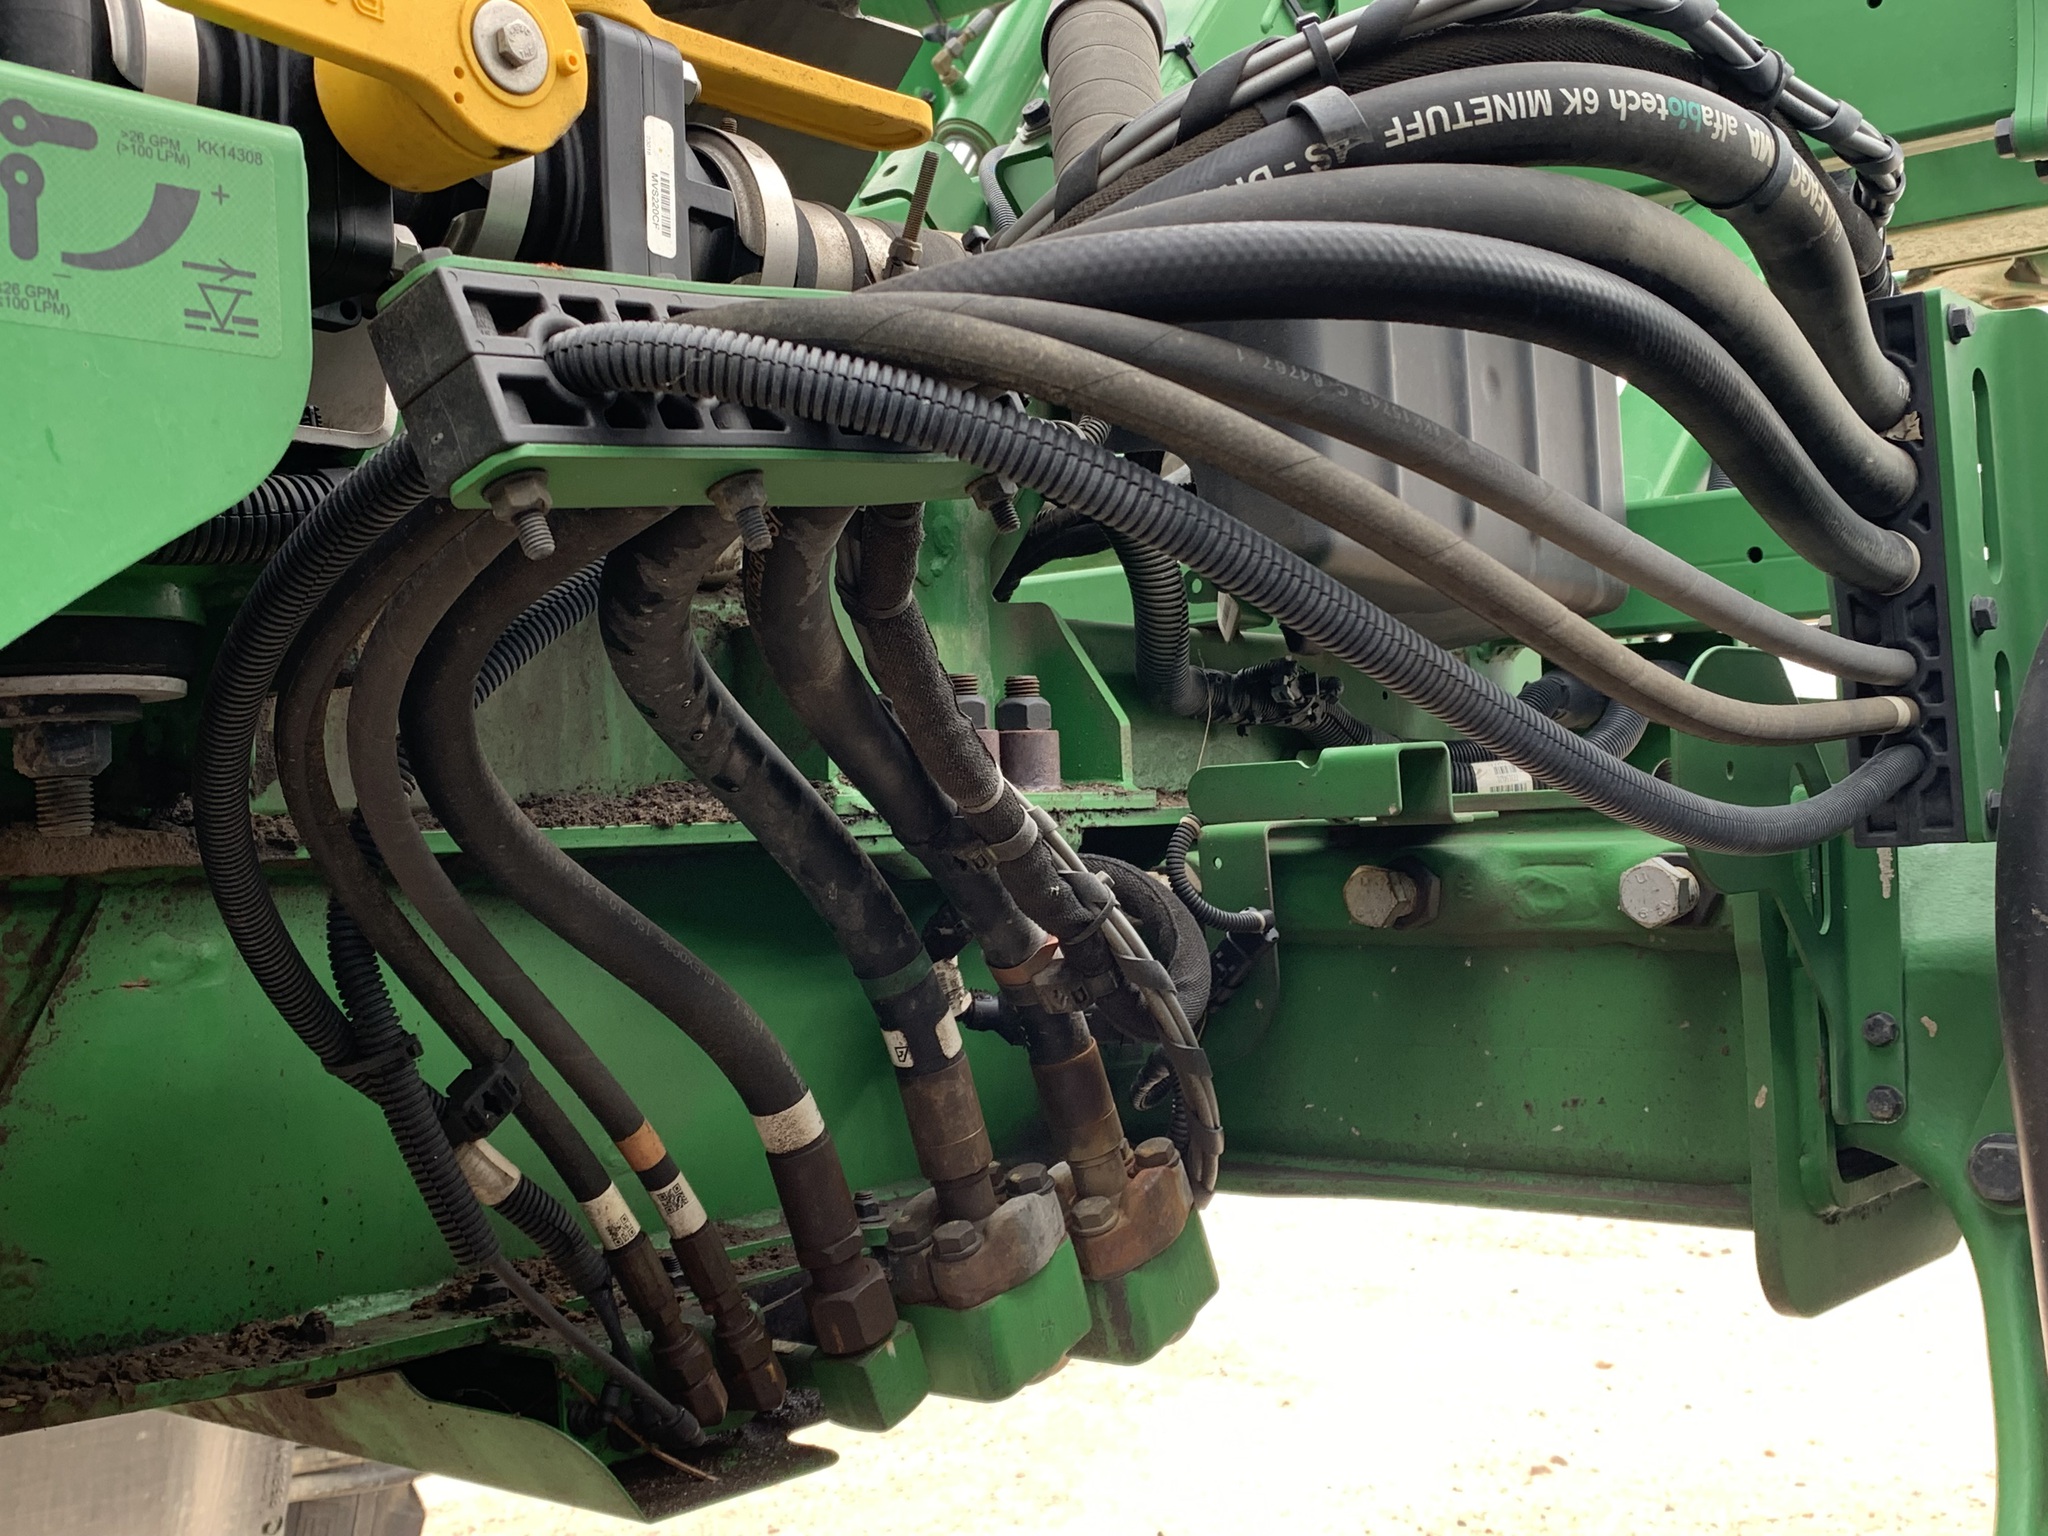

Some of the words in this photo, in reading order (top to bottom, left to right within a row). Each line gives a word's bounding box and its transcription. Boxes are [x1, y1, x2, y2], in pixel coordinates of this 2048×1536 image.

[1559, 87, 1600, 115] 6K
[1384, 88, 1553, 149] MINETUFF
[1608, 88, 1738, 143] alfabiotech
[116, 140, 154, 160] (>100
[157, 147, 191, 169] LPM)
[120, 130, 145, 143] >26
[149, 134, 181, 151] GPM
[197, 139, 263, 167] KK14308
[651, 172, 660, 230] MVS220CF
[25, 284, 60, 302] GPM
[33, 299, 71, 320] LPM)
